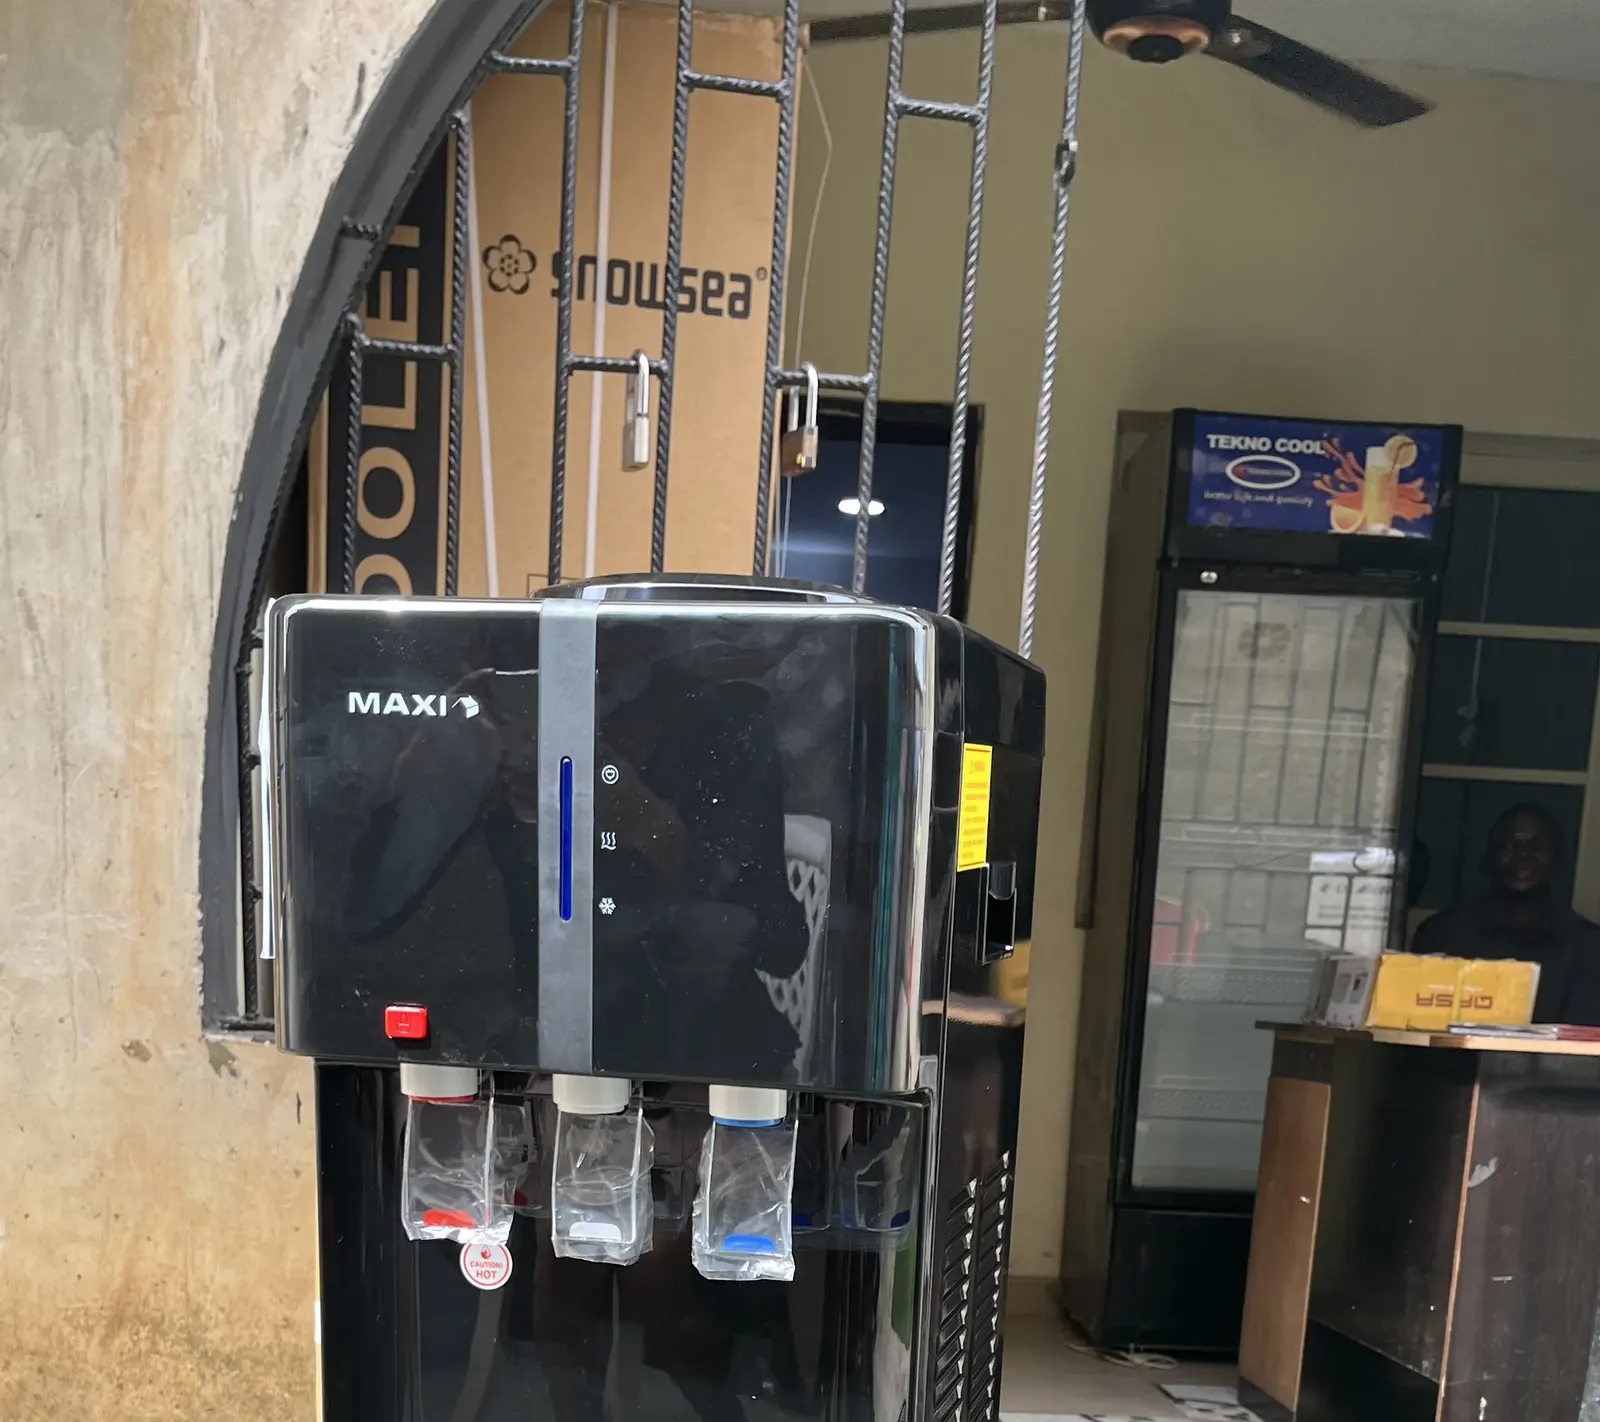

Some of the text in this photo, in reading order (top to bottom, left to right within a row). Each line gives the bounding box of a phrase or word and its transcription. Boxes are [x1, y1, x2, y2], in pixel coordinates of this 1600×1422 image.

[1206, 434, 1327, 455] TEKNO COOL
[348, 691, 447, 717] MAXI
[475, 1270, 498, 1280] HOT
